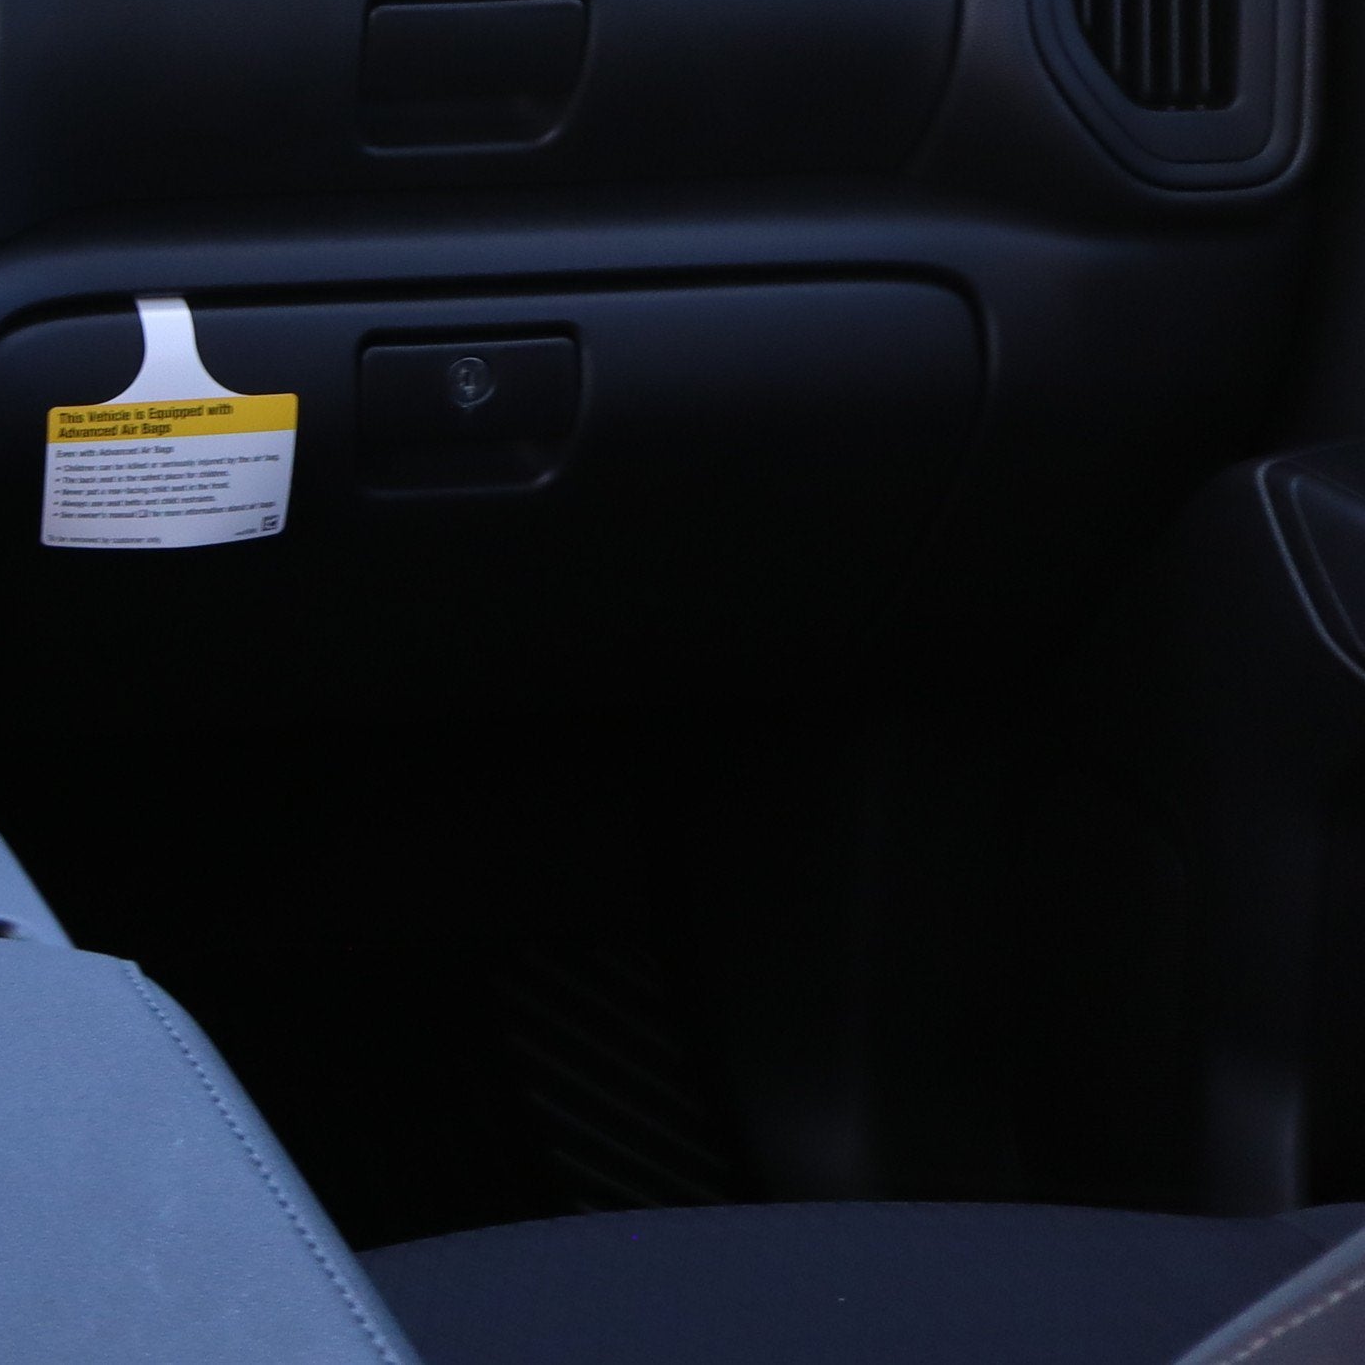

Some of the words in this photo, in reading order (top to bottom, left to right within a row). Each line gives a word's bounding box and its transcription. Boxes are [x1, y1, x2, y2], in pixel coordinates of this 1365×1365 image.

[58, 412, 84, 424] This
[87, 409, 132, 423] Vehicle
[134, 408, 146, 420] is
[148, 404, 205, 421] Equipped
[206, 403, 234, 416] with
[57, 424, 119, 439] Advanced
[120, 423, 139, 436] Air
[140, 422, 173, 436] Bags
